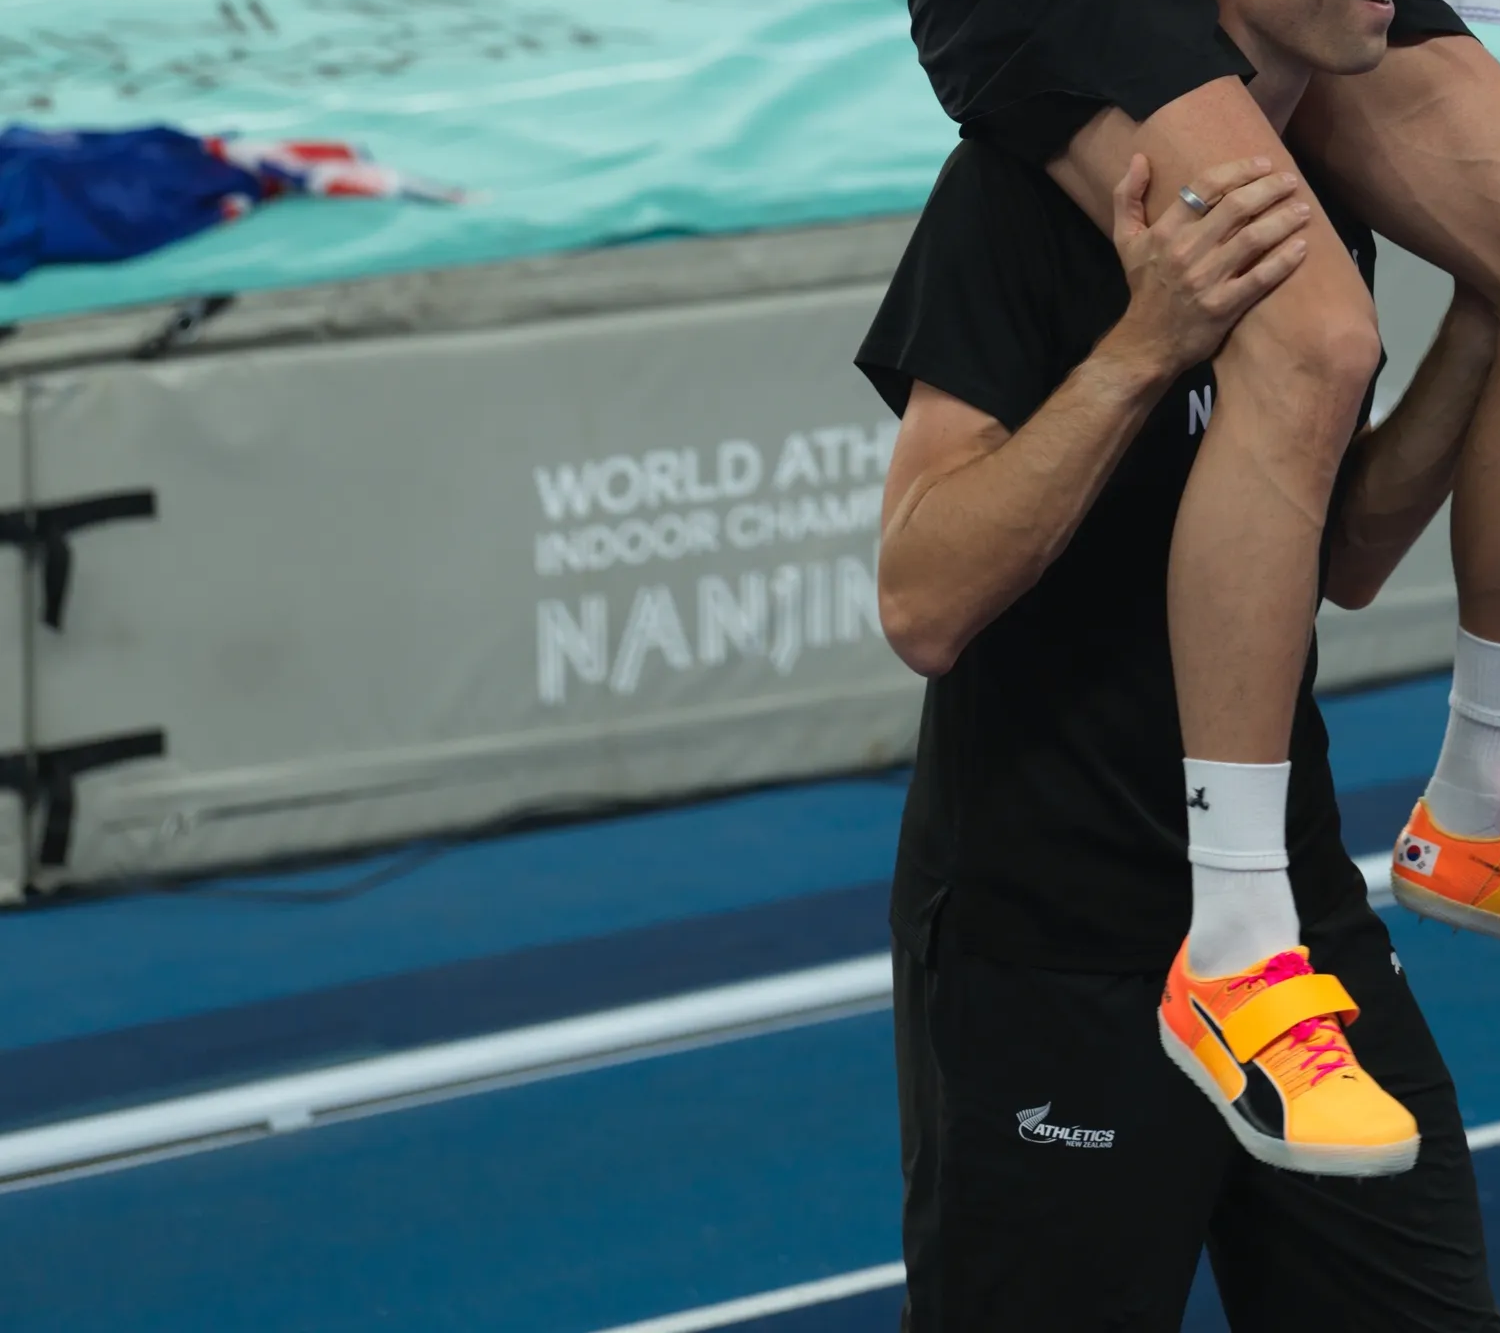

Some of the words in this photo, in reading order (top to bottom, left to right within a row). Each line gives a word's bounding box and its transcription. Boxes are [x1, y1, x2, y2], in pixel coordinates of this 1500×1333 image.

[534, 439, 762, 519] WORLD
[535, 510, 720, 576] INDOOR
[1065, 1140, 1082, 1148] NEW
[1083, 1140, 1112, 1148] ZEALAND
